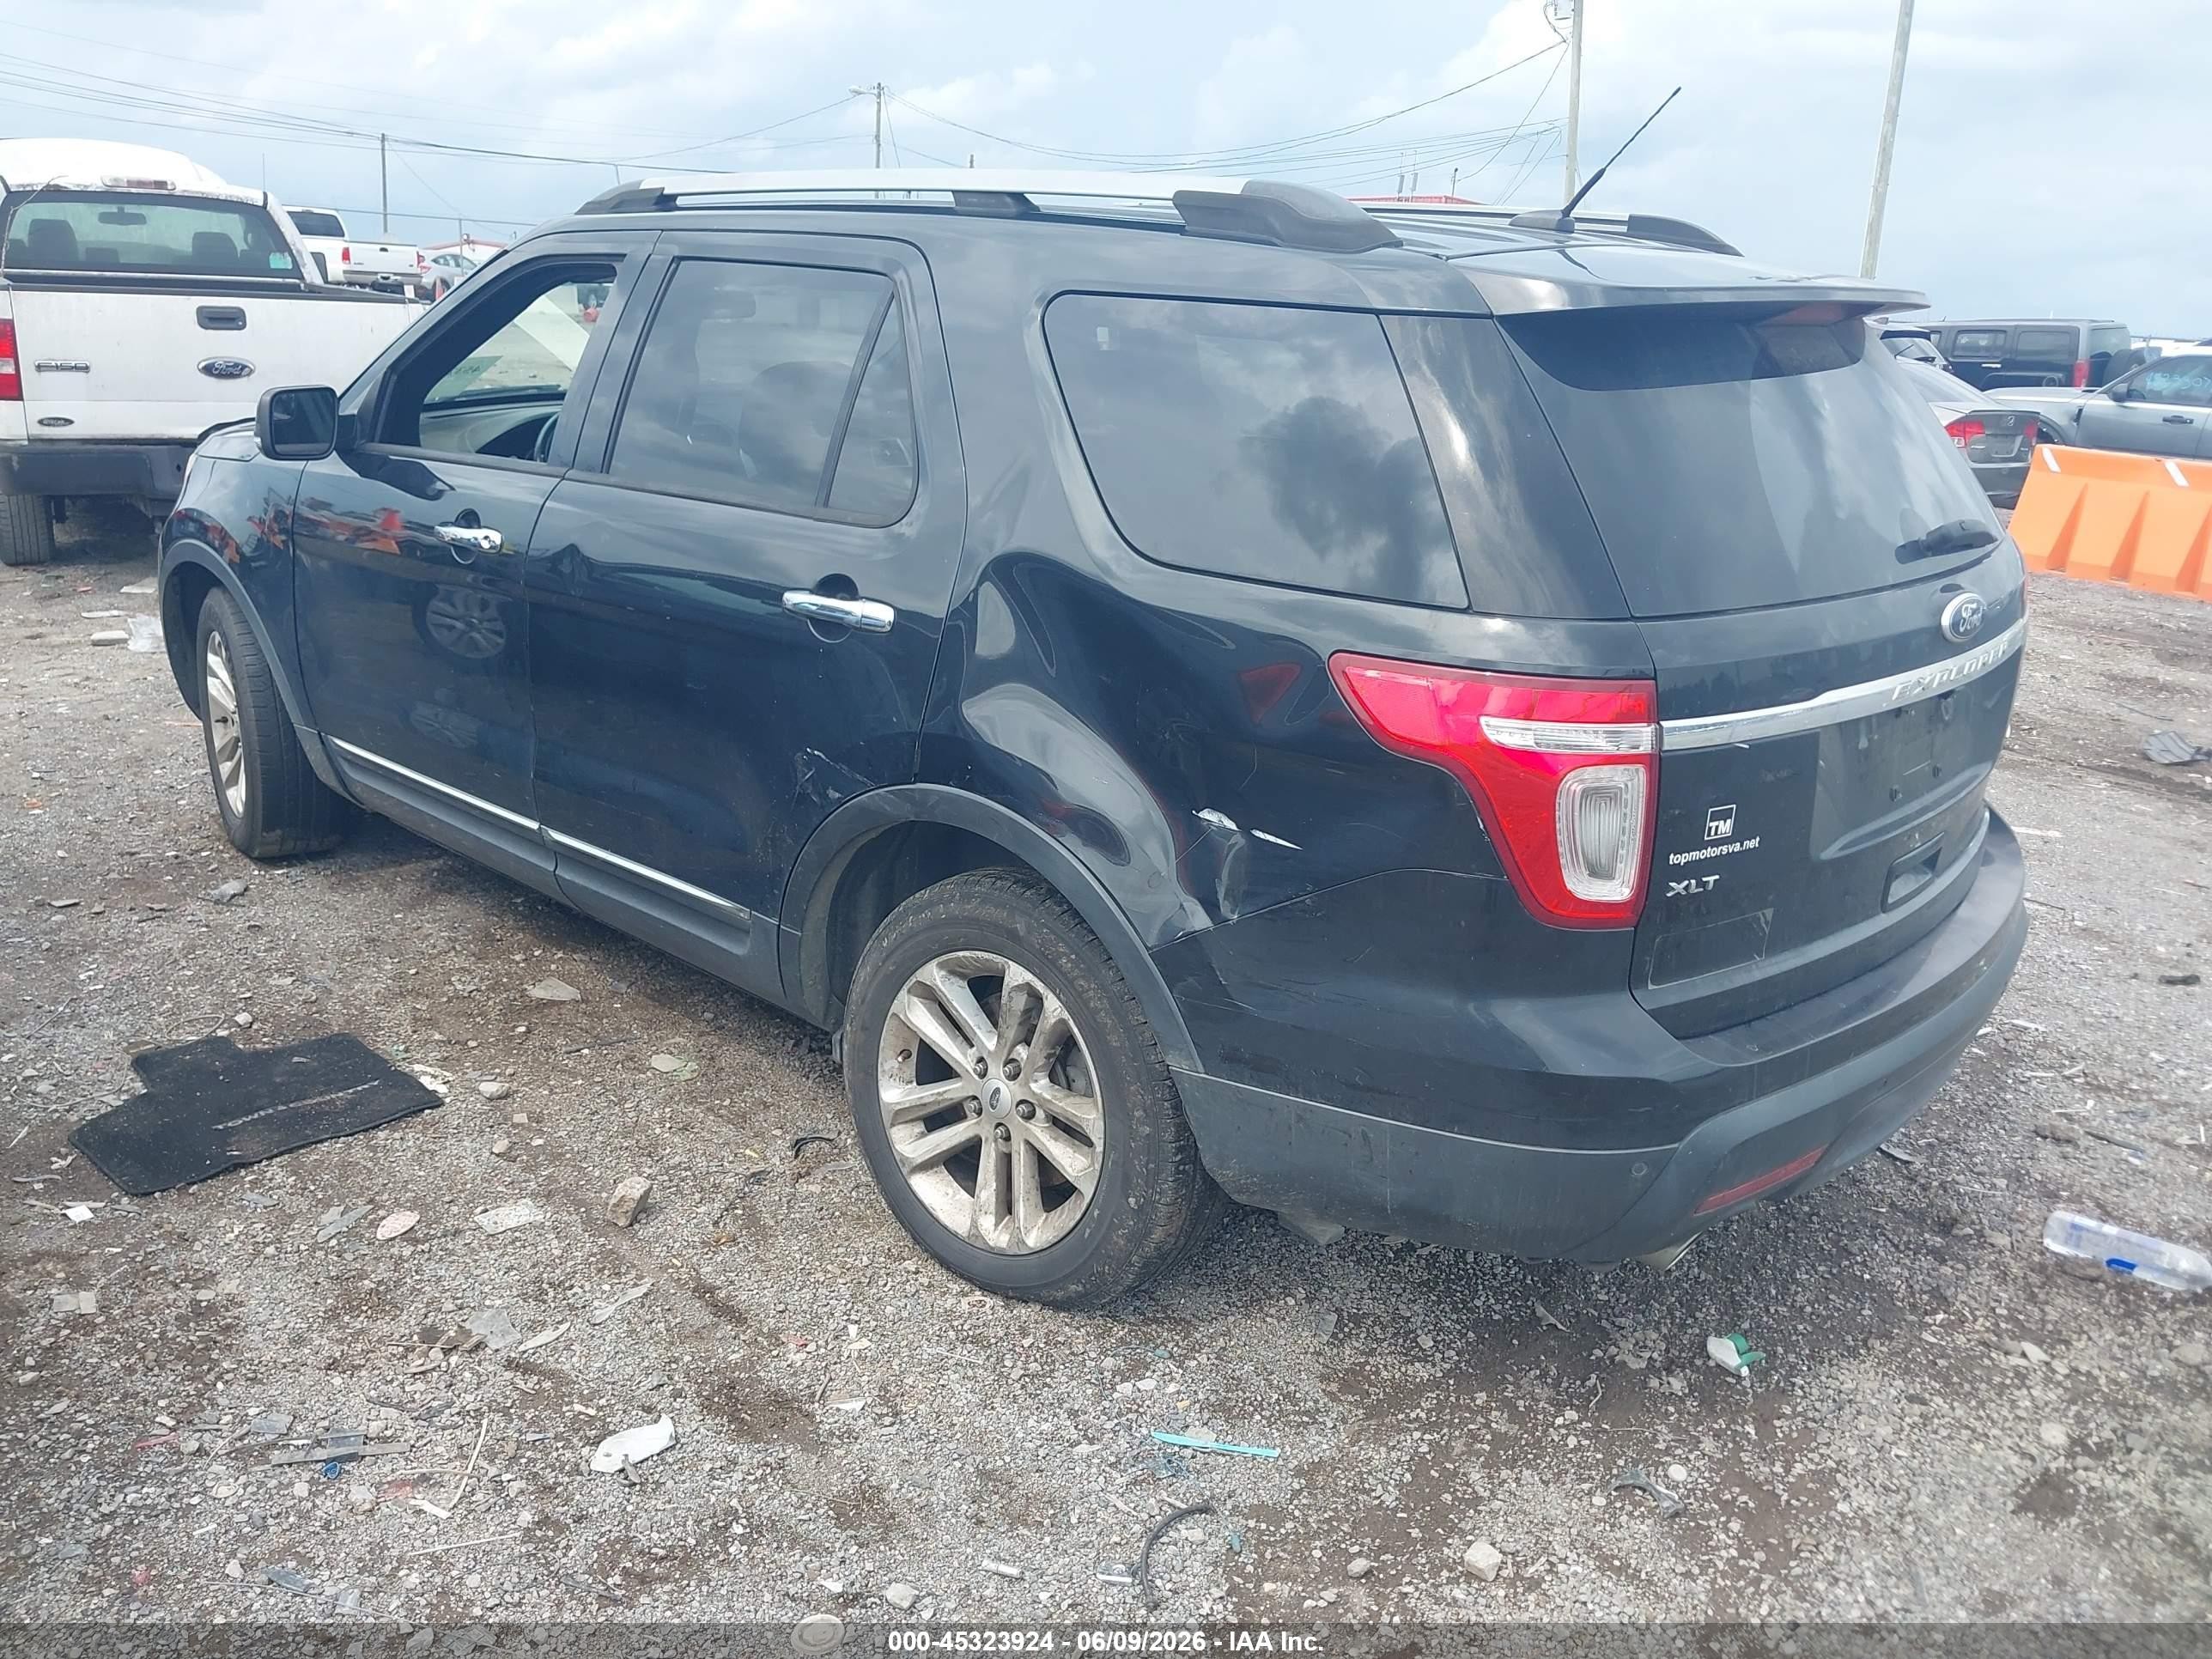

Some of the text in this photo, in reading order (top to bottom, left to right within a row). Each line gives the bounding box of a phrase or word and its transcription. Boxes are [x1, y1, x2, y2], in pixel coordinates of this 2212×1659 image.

[213, 362, 241, 374] Ford
[1960, 603, 1983, 632] Ford
[1709, 818, 1732, 836] TM
[1668, 836, 1760, 866] topmotorsva.net
[1666, 874, 1720, 896] XLT
